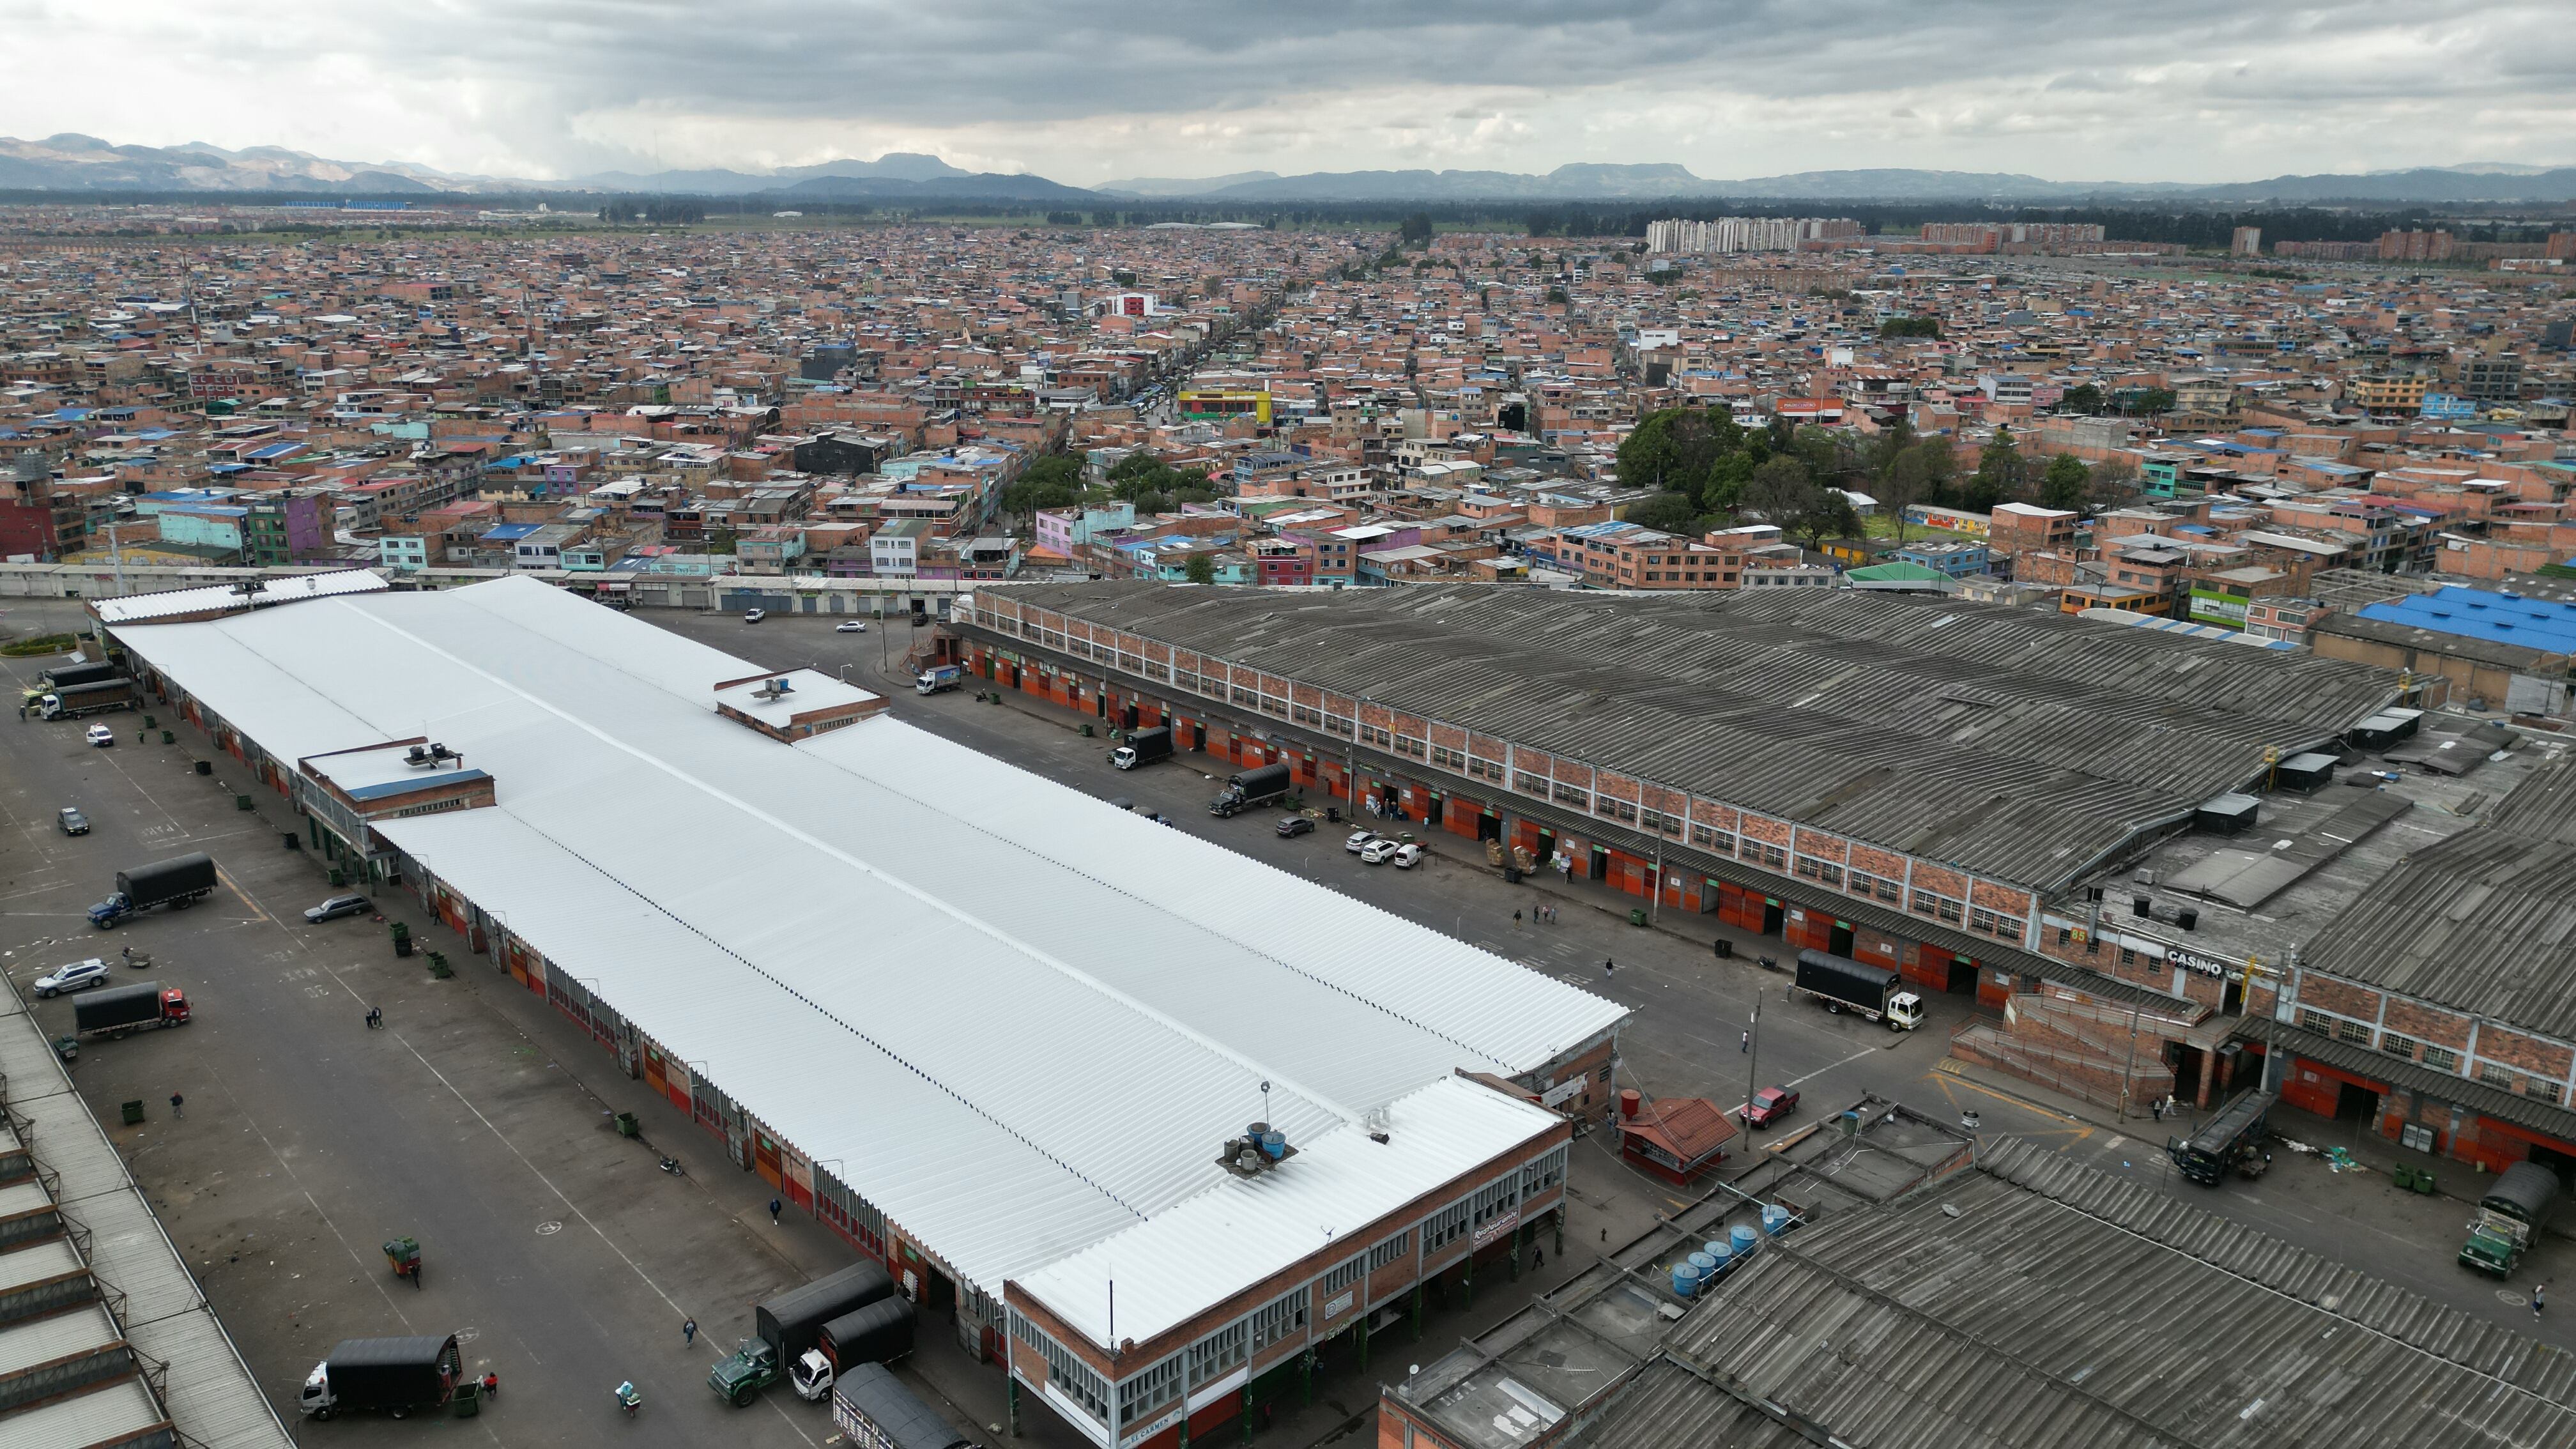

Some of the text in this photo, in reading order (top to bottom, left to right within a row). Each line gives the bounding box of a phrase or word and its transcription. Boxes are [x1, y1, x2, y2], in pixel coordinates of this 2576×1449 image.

[2072, 930, 2085, 941] 85
[2168, 950, 2222, 975] CASINO
[1474, 1211, 1518, 1240] Restaurante
[1131, 1418, 1169, 1443] EL CARMEN
